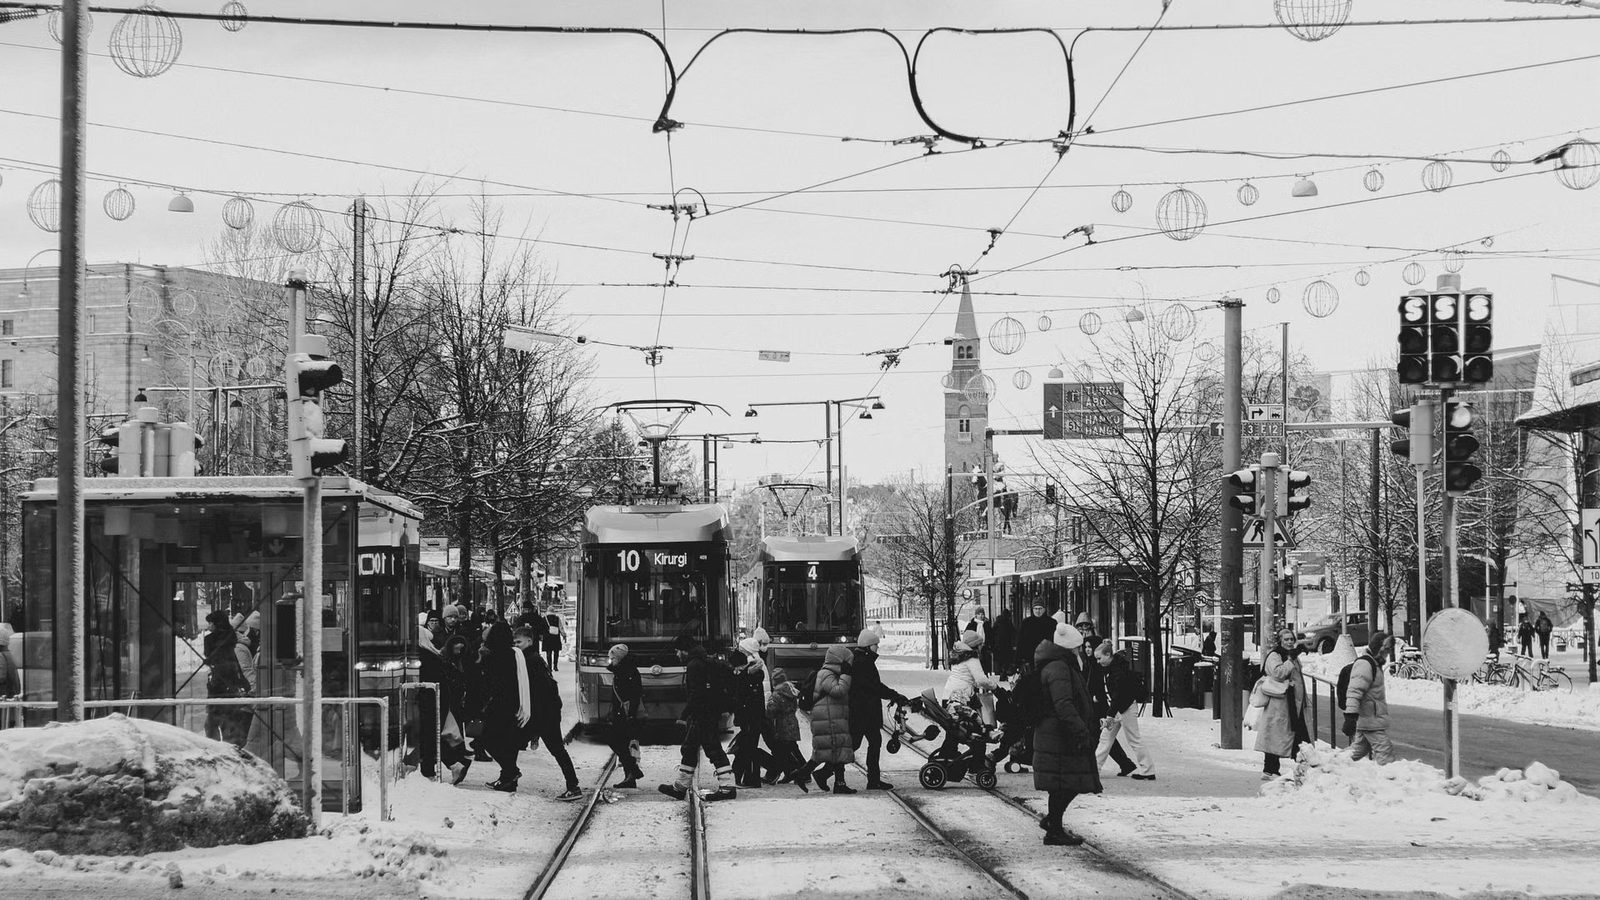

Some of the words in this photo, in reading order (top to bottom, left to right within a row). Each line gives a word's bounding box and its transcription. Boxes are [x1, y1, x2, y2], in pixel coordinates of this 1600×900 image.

[1404, 298, 1423, 321] S
[1435, 296, 1455, 321] S
[1469, 296, 1489, 321] S
[1085, 386, 1119, 396] TURKU
[1247, 424, 1254, 434] 3
[617, 550, 641, 572] 10
[654, 552, 688, 568] Kirurgi
[808, 565, 818, 580] 4
